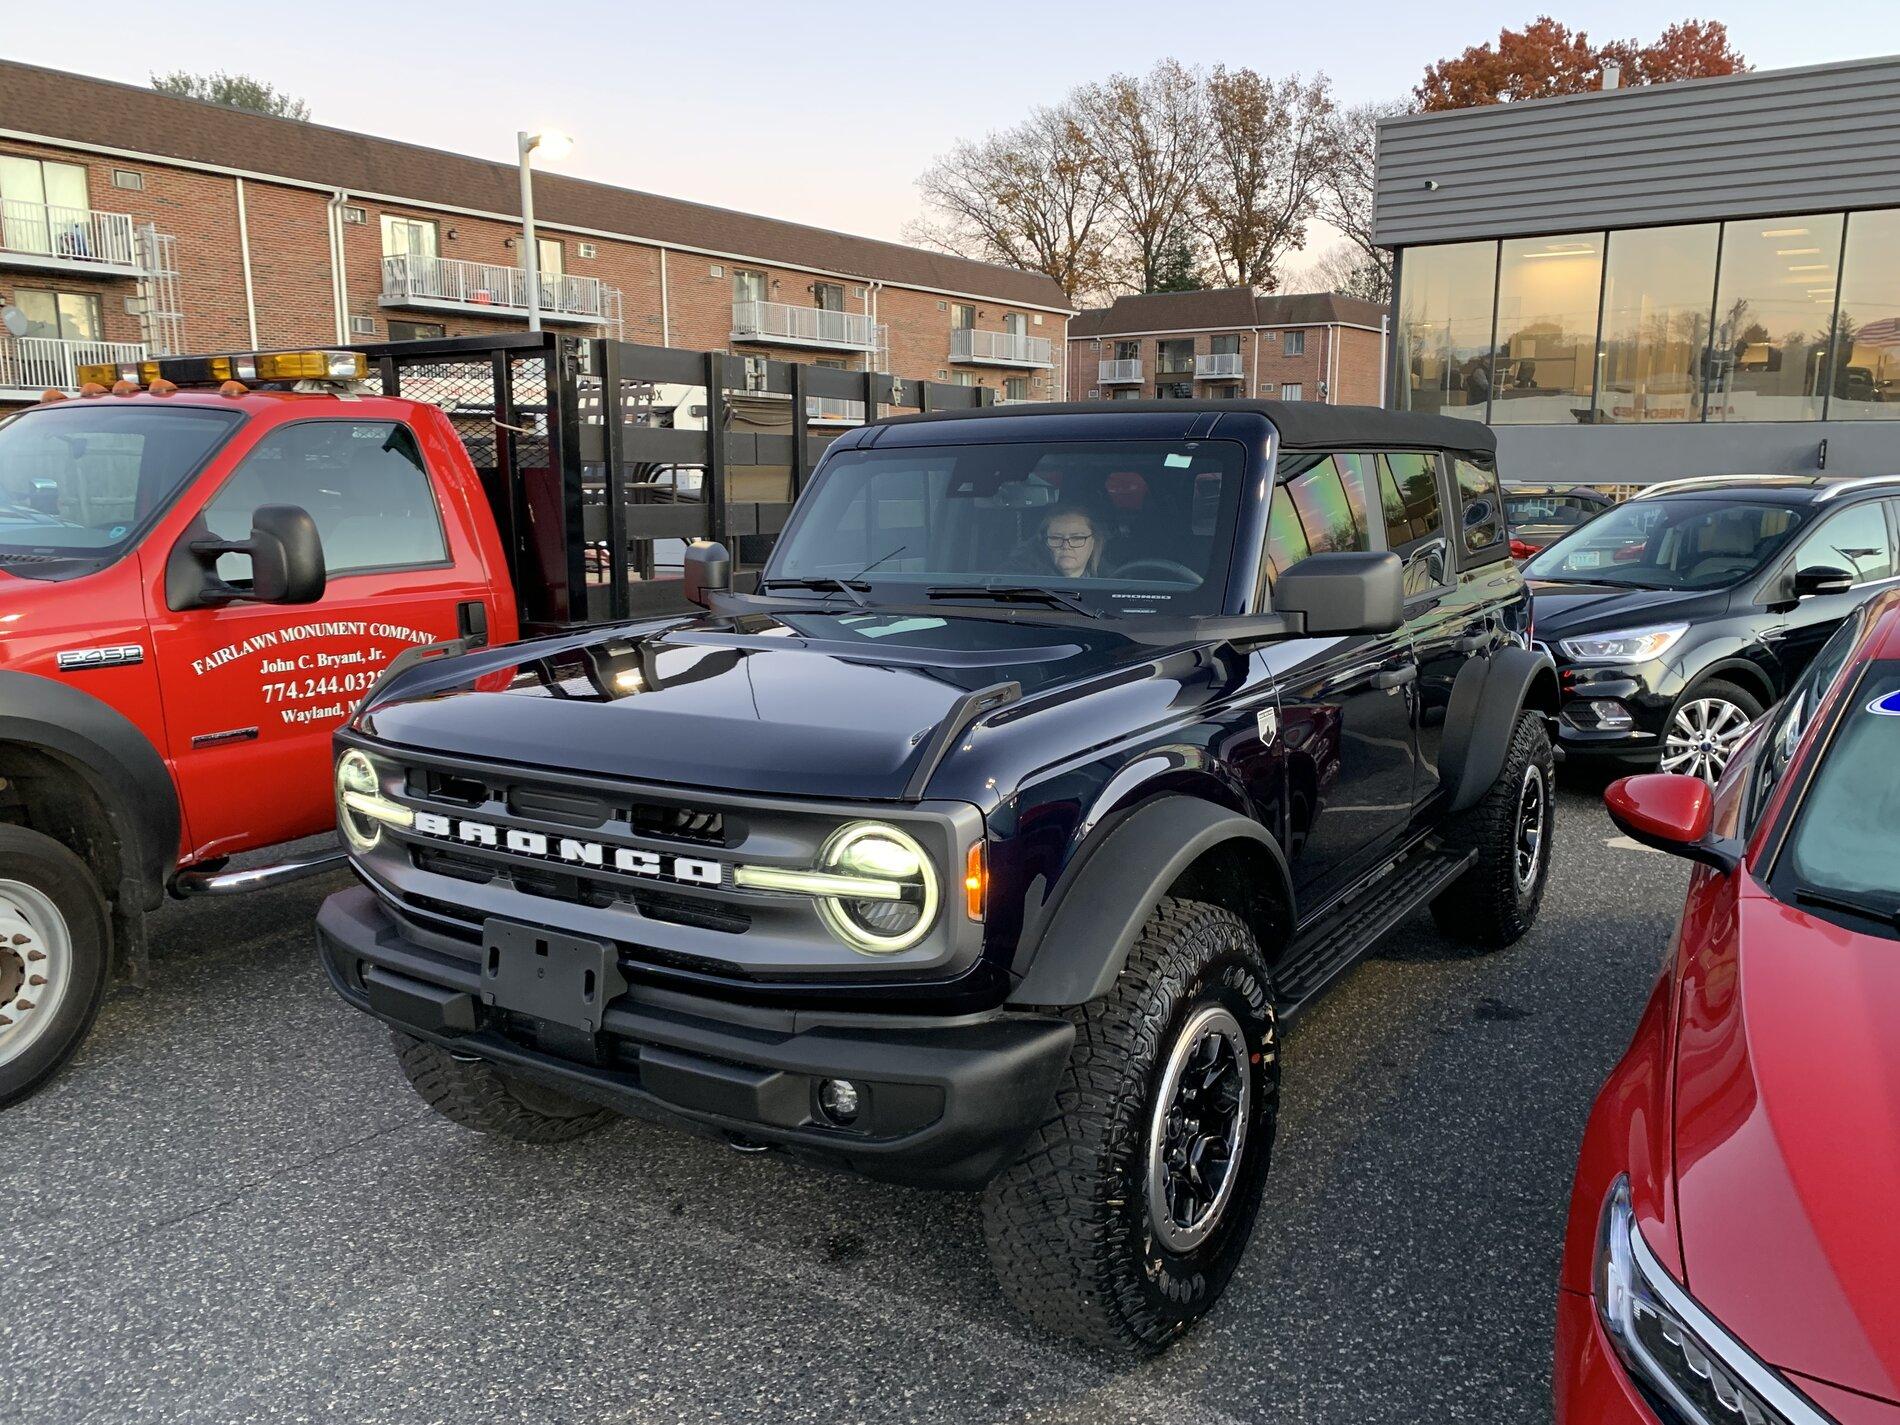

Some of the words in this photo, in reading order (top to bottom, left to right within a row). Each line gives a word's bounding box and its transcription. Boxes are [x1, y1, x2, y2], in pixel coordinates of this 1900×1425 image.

[191, 631, 278, 676] FAIRLAWN
[278, 621, 368, 643] MONUMENT
[369, 622, 437, 645] COMPANY
[260, 658, 295, 674] John
[298, 655, 314, 669] C.
[317, 650, 366, 669] Bryant,
[368, 647, 386, 661] Jr.
[281, 702, 345, 723] Wayland,
[415, 811, 722, 885] BRONCO
